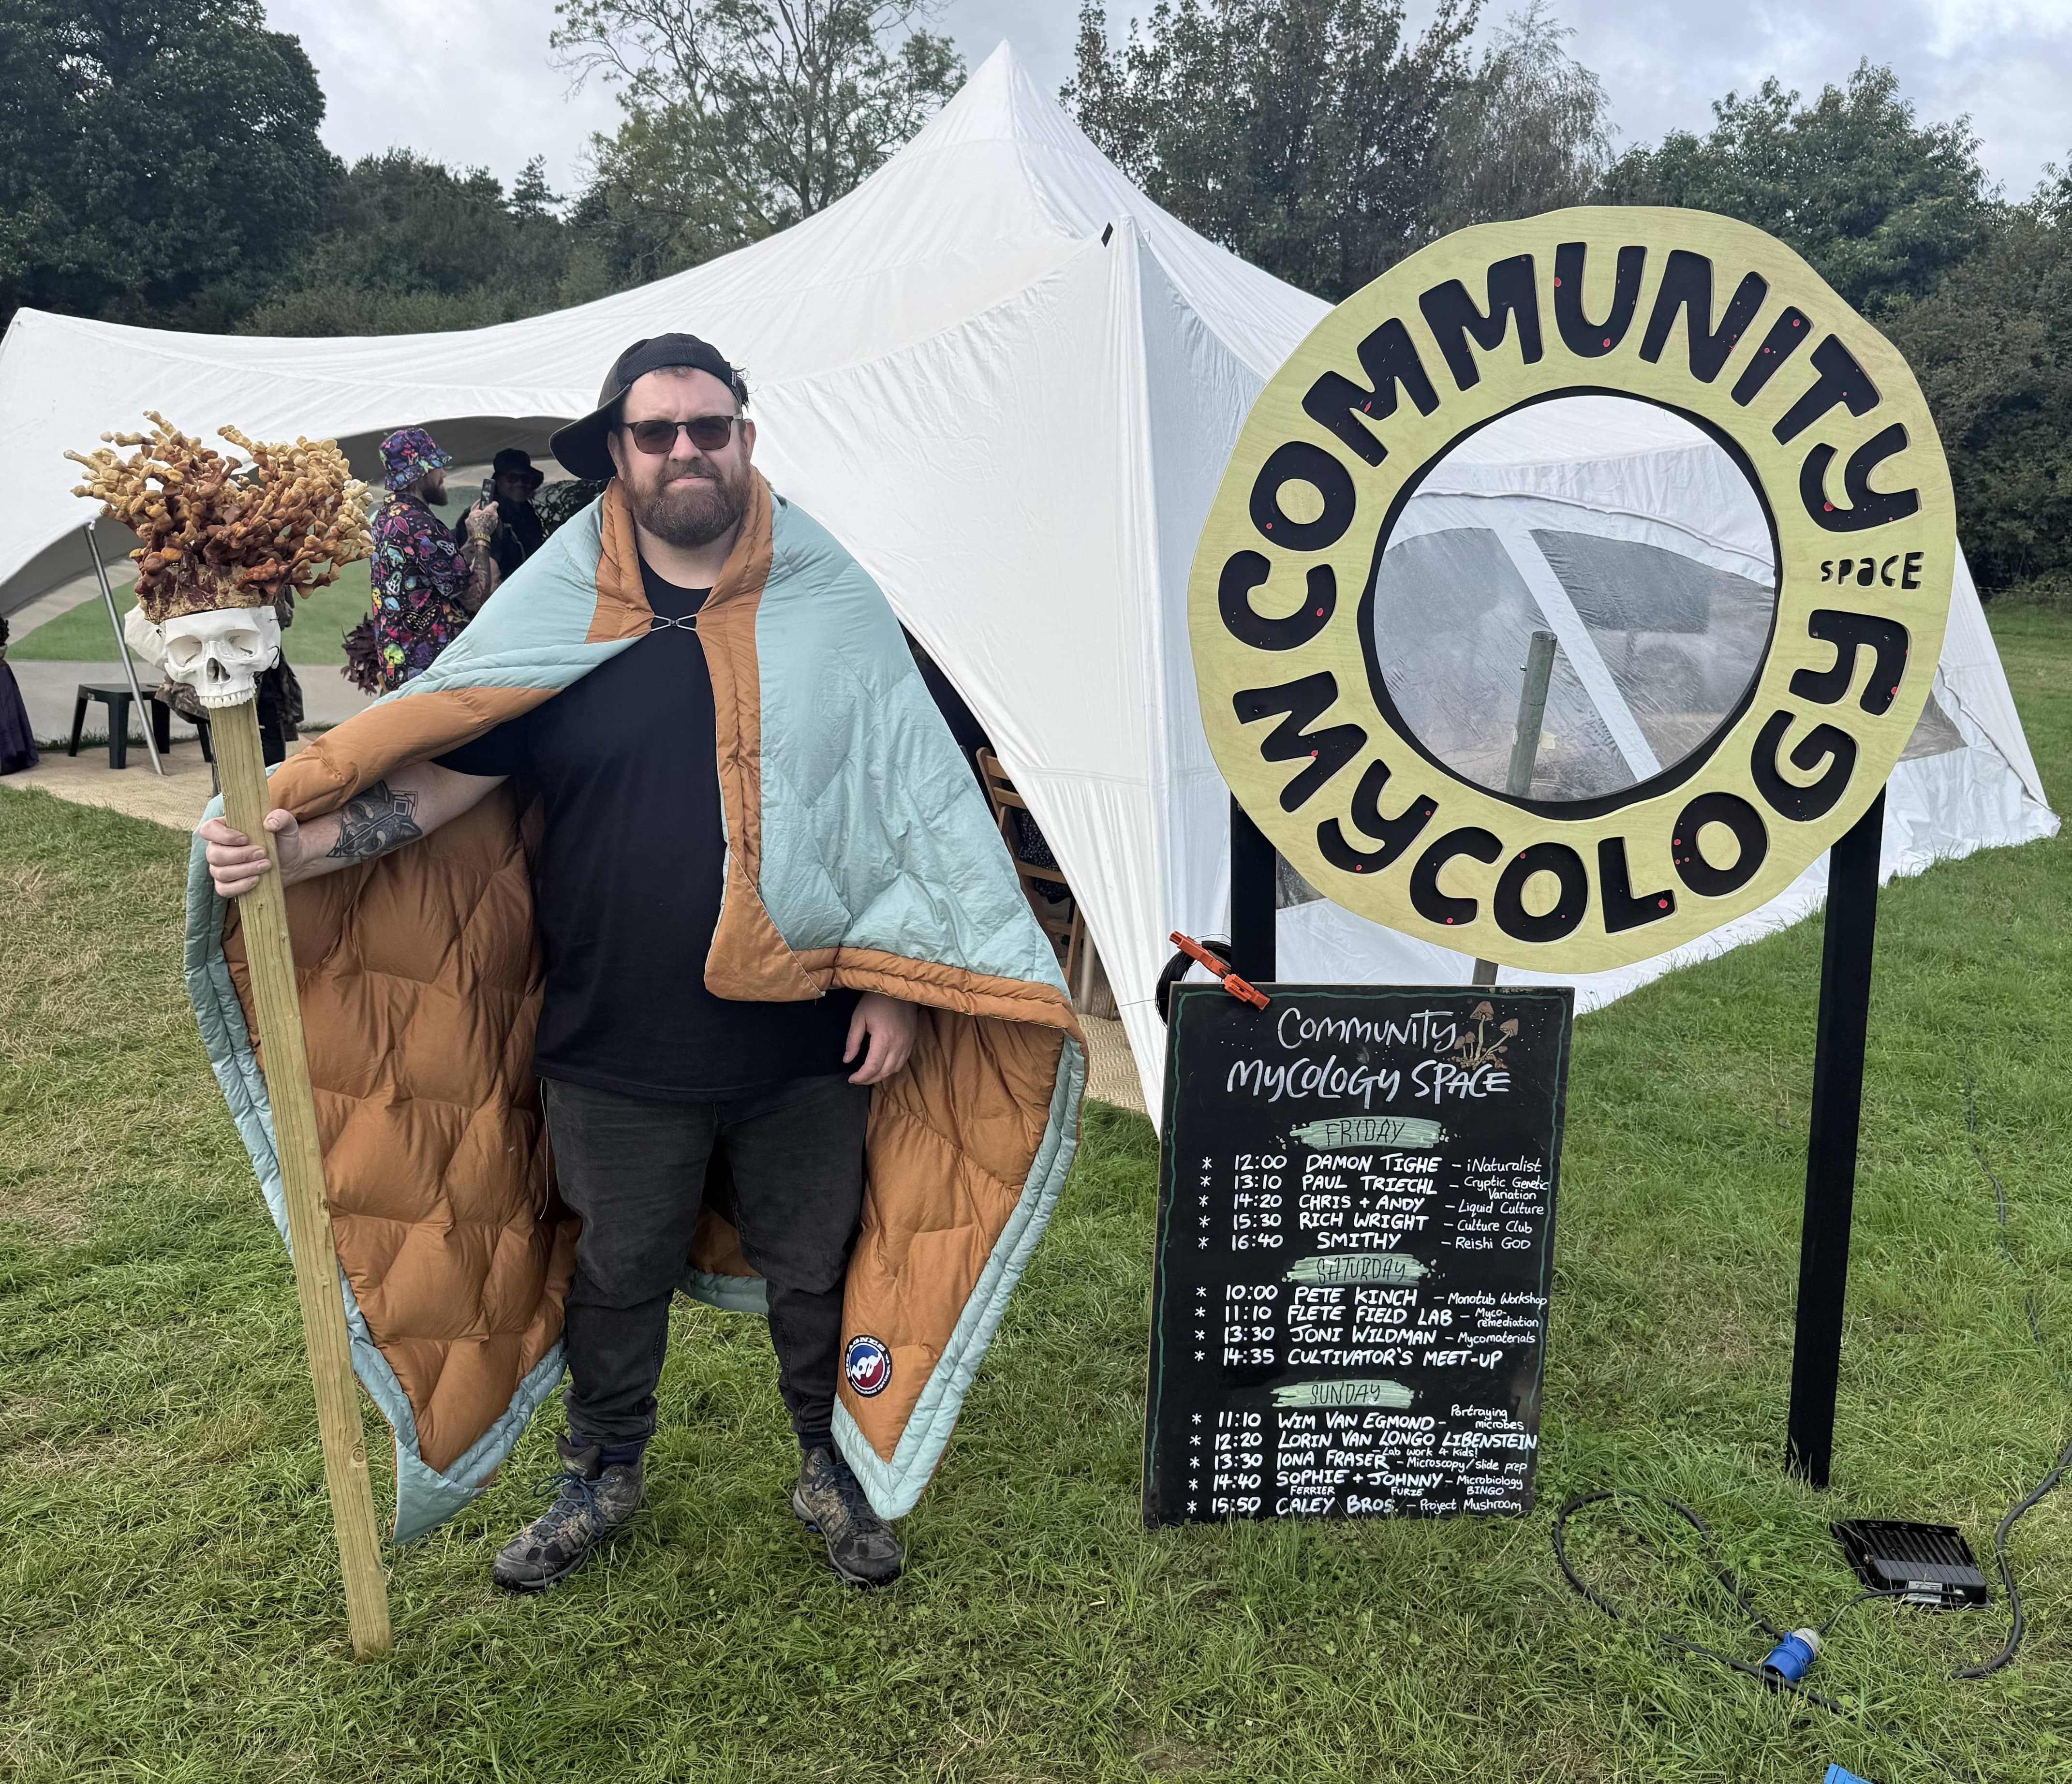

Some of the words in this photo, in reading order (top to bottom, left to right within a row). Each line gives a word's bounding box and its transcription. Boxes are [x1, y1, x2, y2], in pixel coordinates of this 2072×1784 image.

[1218, 242, 1921, 651] COMMUNITY
[1232, 608, 1910, 942] MYCOLOGY
[1227, 1054, 1400, 1109] MYCOLOGY
[1411, 1059, 1511, 1105] SPACE
[1325, 1119, 1405, 1146] FRIDAY
[1235, 1154, 1288, 1171] 12:00
[1305, 1154, 1373, 1173] DAMON
[1379, 1152, 1443, 1174] TIGHE
[1467, 1155, 1542, 1173] iNaturalist
[1234, 1174, 1282, 1190] 13:10
[1302, 1174, 1347, 1191] PAUL
[1360, 1175, 1437, 1195] TRIECHL
[1464, 1175, 1506, 1193] Cryptic
[1512, 1175, 1549, 1190] Genetic
[1488, 1187, 1537, 1200] Variation
[1234, 1193, 1282, 1210] 14:20
[1299, 1194, 1351, 1211] CHRIS
[1375, 1194, 1425, 1213] ANDY
[1458, 1199, 1494, 1218] Liquid
[1500, 1201, 1544, 1215] Culture
[1233, 1213, 1282, 1231] 15:30
[1299, 1211, 1343, 1230] RICH
[1353, 1212, 1429, 1231] WRIGHT
[1457, 1218, 1500, 1232] Culture
[1505, 1220, 1533, 1234] Club
[1232, 1233, 1283, 1251] 16:40
[1317, 1231, 1402, 1250] SMITHY
[1455, 1236, 1493, 1250] Reishi
[1501, 1237, 1531, 1250] GOD
[1317, 1258, 1405, 1283] SATURDAY
[1226, 1284, 1278, 1301] 10:00
[1294, 1286, 1346, 1305] PETE
[1354, 1286, 1418, 1307] KINCH
[1447, 1290, 1496, 1305] Monotub
[1500, 1291, 1548, 1310] Workshop
[1225, 1305, 1272, 1323] 11:10
[1288, 1303, 1346, 1325] FLETE
[1356, 1305, 1407, 1324] FIELD
[1417, 1308, 1453, 1327] LAB
[1475, 1307, 1509, 1322] Myco-
[1477, 1314, 1539, 1328] remediation
[1224, 1325, 1275, 1344] 13:30
[1289, 1324, 1344, 1343] JONI
[1352, 1325, 1437, 1346] WILDMAN
[1457, 1330, 1536, 1348] Mycomaterials
[1223, 1347, 1274, 1366] 14:35
[1422, 1350, 1503, 1370] MEET-UP
[1309, 1382, 1380, 1405] SUNDAY
[1218, 1411, 1261, 1428] 11:10
[1278, 1412, 1316, 1430] WIM
[1326, 1411, 1358, 1429] VAN
[1362, 1412, 1435, 1431] EGMOND
[1450, 1404, 1508, 1422] Portraying
[1475, 1417, 1524, 1431] microbes
[1214, 1432, 1263, 1451] 12:20
[1278, 1430, 1332, 1449] LORIN
[1341, 1430, 1373, 1447] VAN
[1378, 1430, 1436, 1447] LONGO
[1440, 1431, 1538, 1451] LIBENSTEIN
[1382, 1446, 1402, 1457] Lab
[1406, 1447, 1433, 1457] work
[1214, 1453, 1263, 1470] 13:30
[1276, 1451, 1315, 1471] IONA
[1326, 1448, 1391, 1470] FRASER
[1504, 1462, 1528, 1475] prep
[1213, 1473, 1261, 1492] 14:40
[1276, 1469, 1350, 1487] SOPHIE
[1367, 1470, 1444, 1489] JOHNNY
[1456, 1474, 1523, 1491] Microbiology
[1290, 1485, 1335, 1496] FERRIER
[1391, 1486, 1425, 1497] FURZE
[1466, 1485, 1505, 1496] BINGO
[1212, 1497, 1261, 1514] 15:50
[1276, 1497, 1335, 1515] CALEY
[1420, 1497, 1458, 1515] Project
[1463, 1497, 1523, 1512] Mushroom
